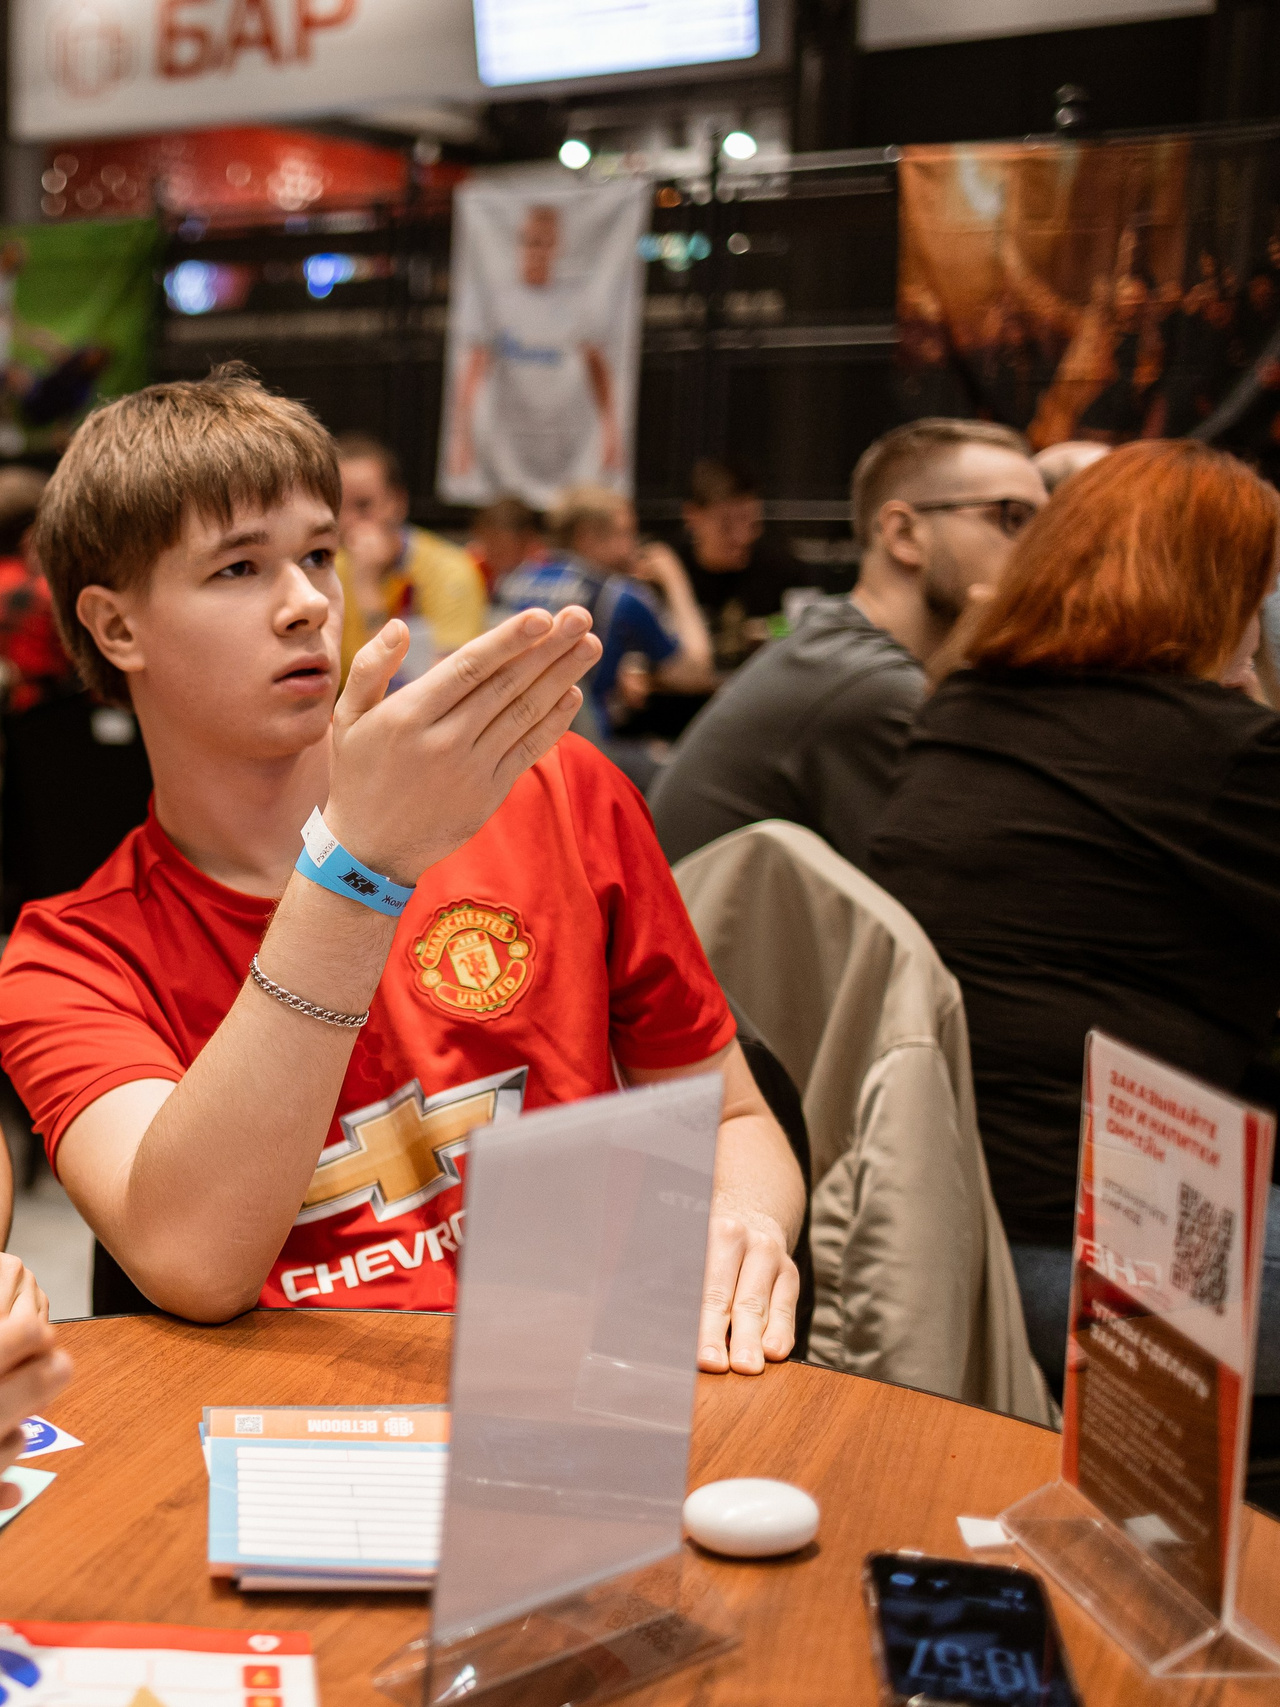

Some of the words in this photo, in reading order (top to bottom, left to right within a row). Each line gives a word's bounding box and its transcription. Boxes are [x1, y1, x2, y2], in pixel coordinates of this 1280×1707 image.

[154, 0, 357, 84] БАР
[425, 912, 510, 961] MANCHESTER
[456, 976, 516, 1006] UNITED
[307, 1418, 378, 1434] BETBOOM
[908, 1638, 1050, 1698] 19:57
